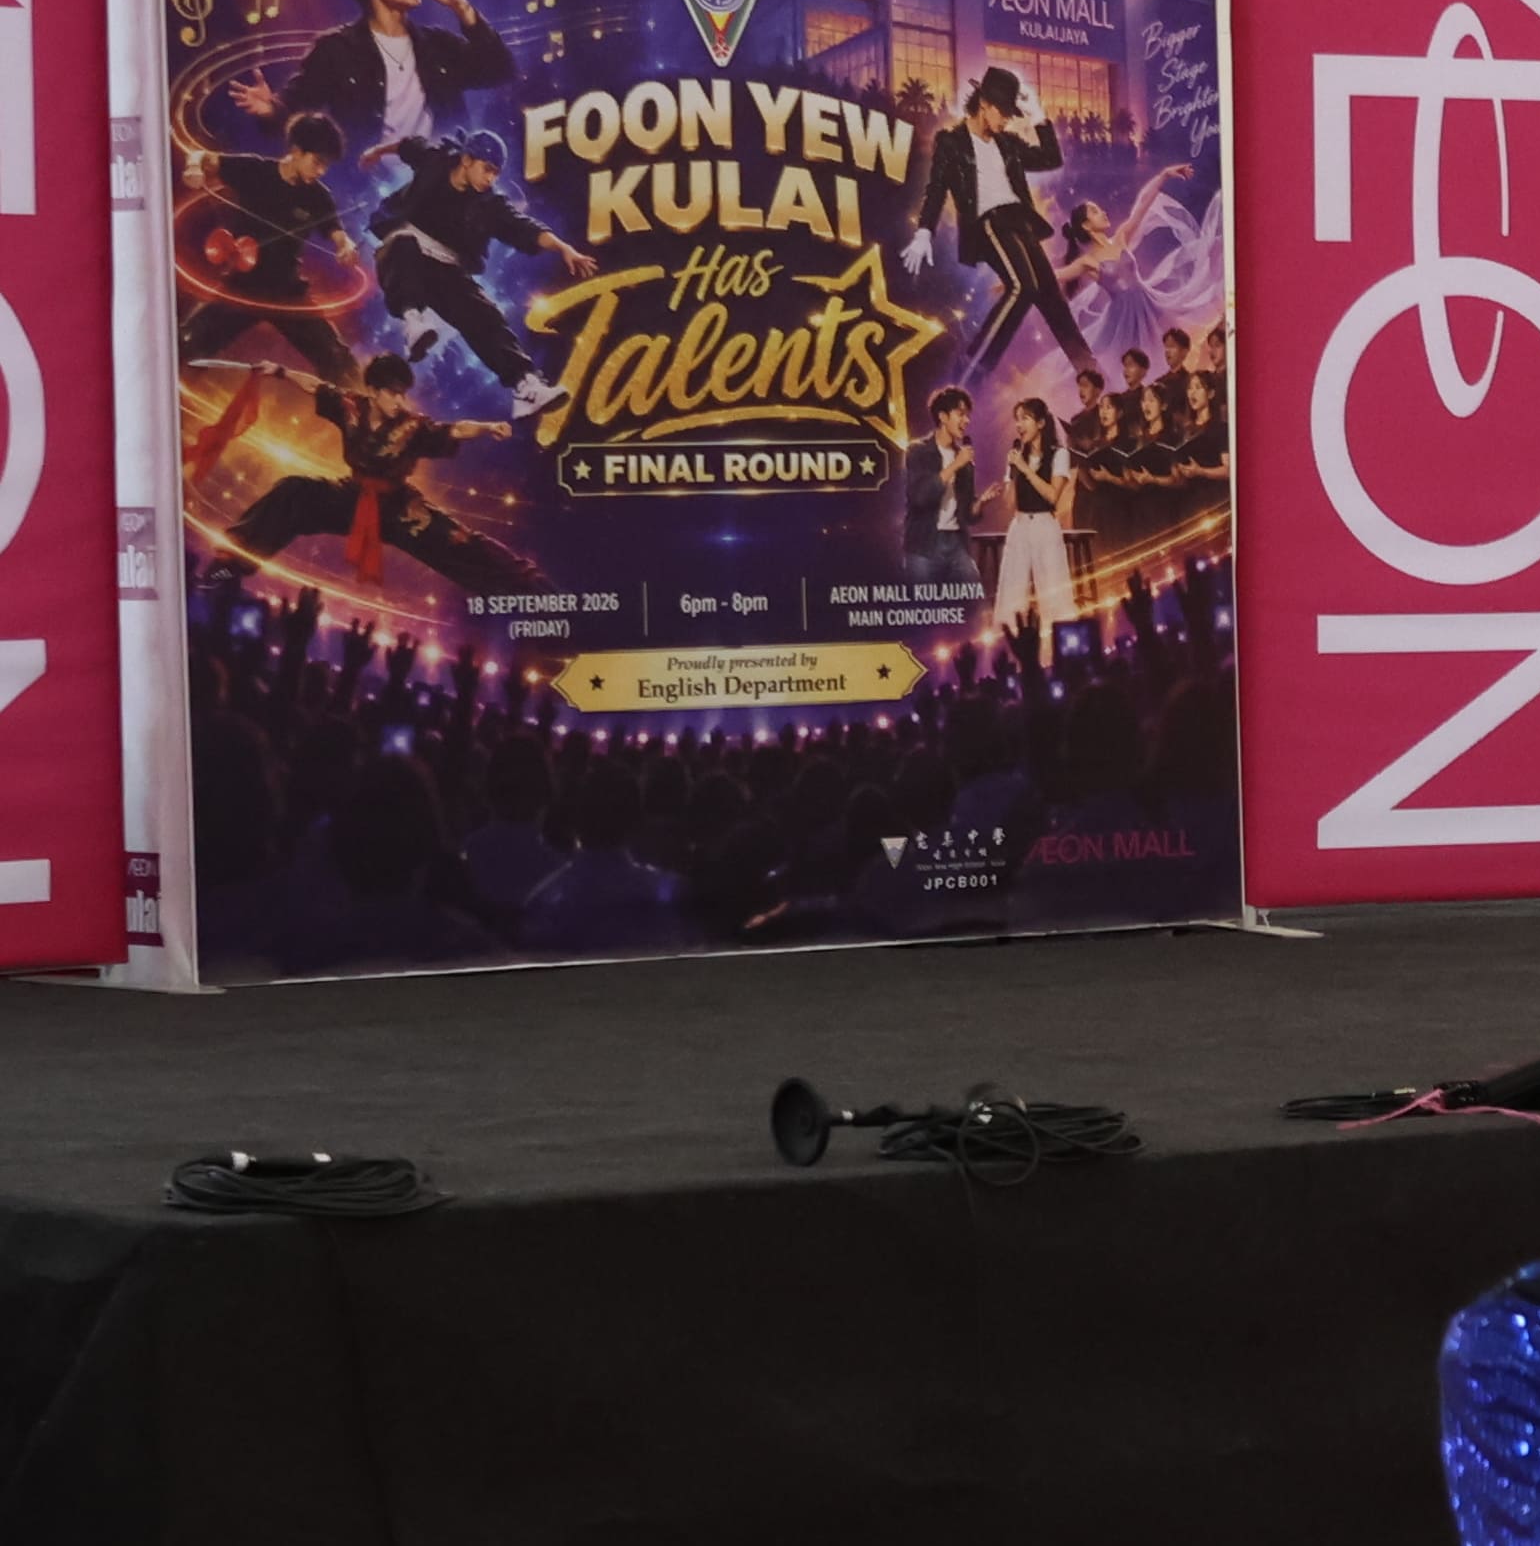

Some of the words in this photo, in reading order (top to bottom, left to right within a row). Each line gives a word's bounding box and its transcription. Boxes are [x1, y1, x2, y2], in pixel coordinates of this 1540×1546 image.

[1020, 20, 1090, 46] KULAIJAYA
[1142, 20, 1201, 61] Bigger
[1156, 57, 1209, 94] Stage
[524, 78, 732, 182] FOON
[747, 80, 915, 184] YEW
[587, 159, 863, 248] KULAI
[668, 243, 785, 312] Has
[524, 264, 890, 448] Talents
[603, 455, 716, 487] FINAL
[723, 451, 853, 484] ROUND
[466, 596, 485, 615] 18
[488, 593, 578, 614] SEPTEMBER
[582, 592, 620, 612] 2026
[680, 593, 717, 618] 6pm
[732, 592, 769, 616] 8pm
[830, 585, 869, 605] AEON
[872, 584, 910, 604] MALL
[914, 582, 985, 602] KULAIJAYA
[508, 618, 571, 640] (FRIDAY)
[848, 610, 884, 628] MAIN
[887, 607, 966, 627] CONCOURSE
[667, 655, 725, 673] Proudly
[729, 654, 799, 673] presented
[801, 652, 818, 670] by
[638, 677, 718, 703] English
[724, 672, 847, 700] Department
[1112, 829, 1196, 860] MALL
